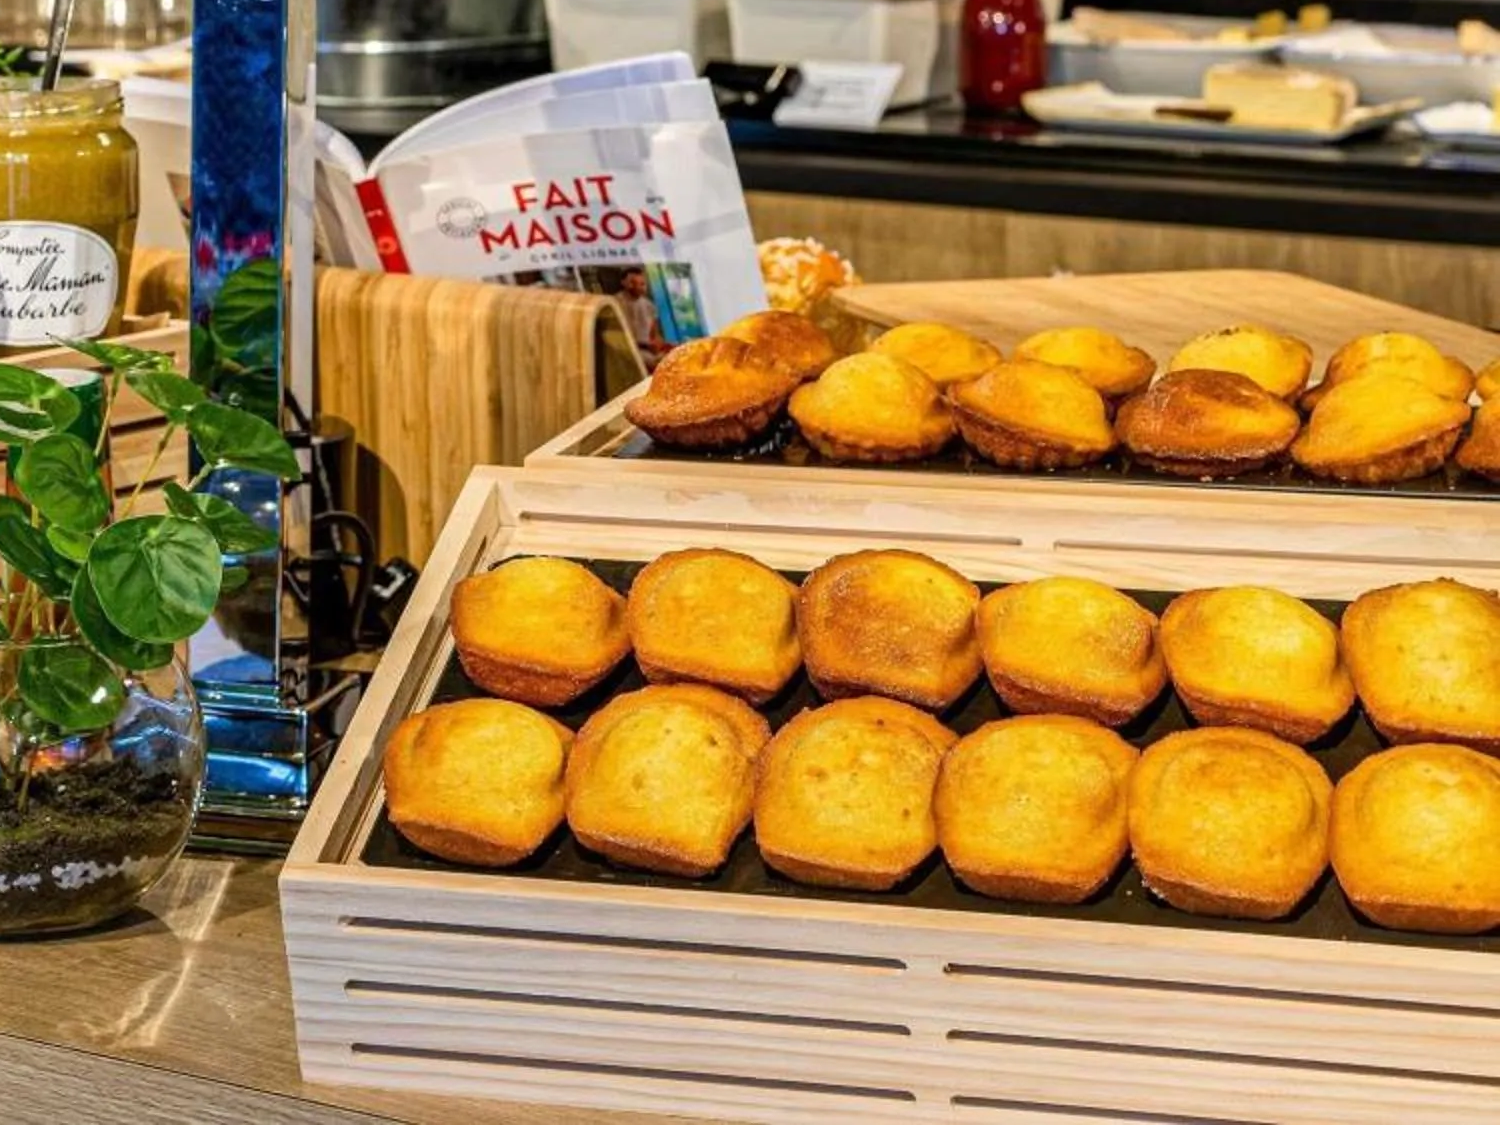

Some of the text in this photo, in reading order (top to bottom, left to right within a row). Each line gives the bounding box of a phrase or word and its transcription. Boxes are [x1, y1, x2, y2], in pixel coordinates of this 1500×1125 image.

[513, 176, 613, 213] FAIT
[480, 209, 675, 254] MAISON
[580, 247, 640, 259] LIGNAC
[16, 257, 106, 292] Maman
